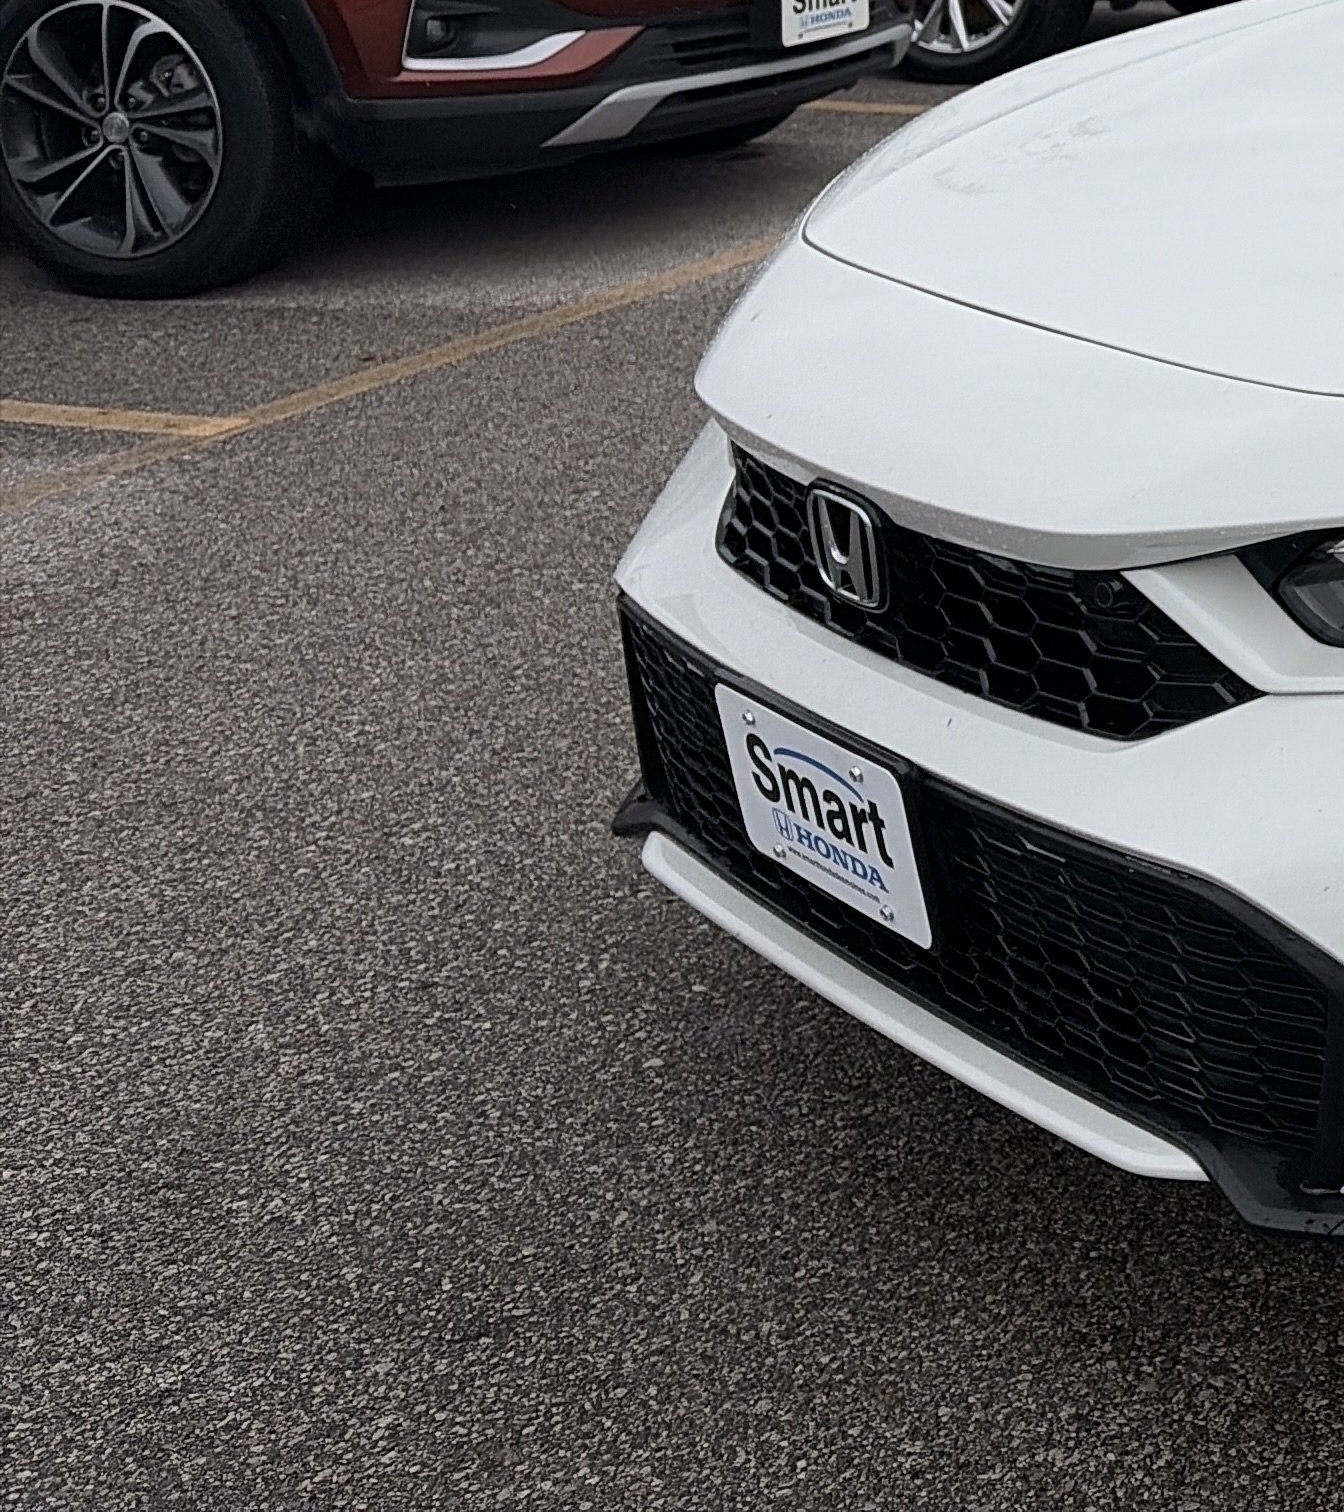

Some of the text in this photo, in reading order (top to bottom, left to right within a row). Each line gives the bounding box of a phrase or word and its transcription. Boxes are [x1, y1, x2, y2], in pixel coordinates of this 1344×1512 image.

[810, 8, 852, 24] HONDA
[746, 733, 895, 870] Smart
[796, 822, 890, 894] HONDA
